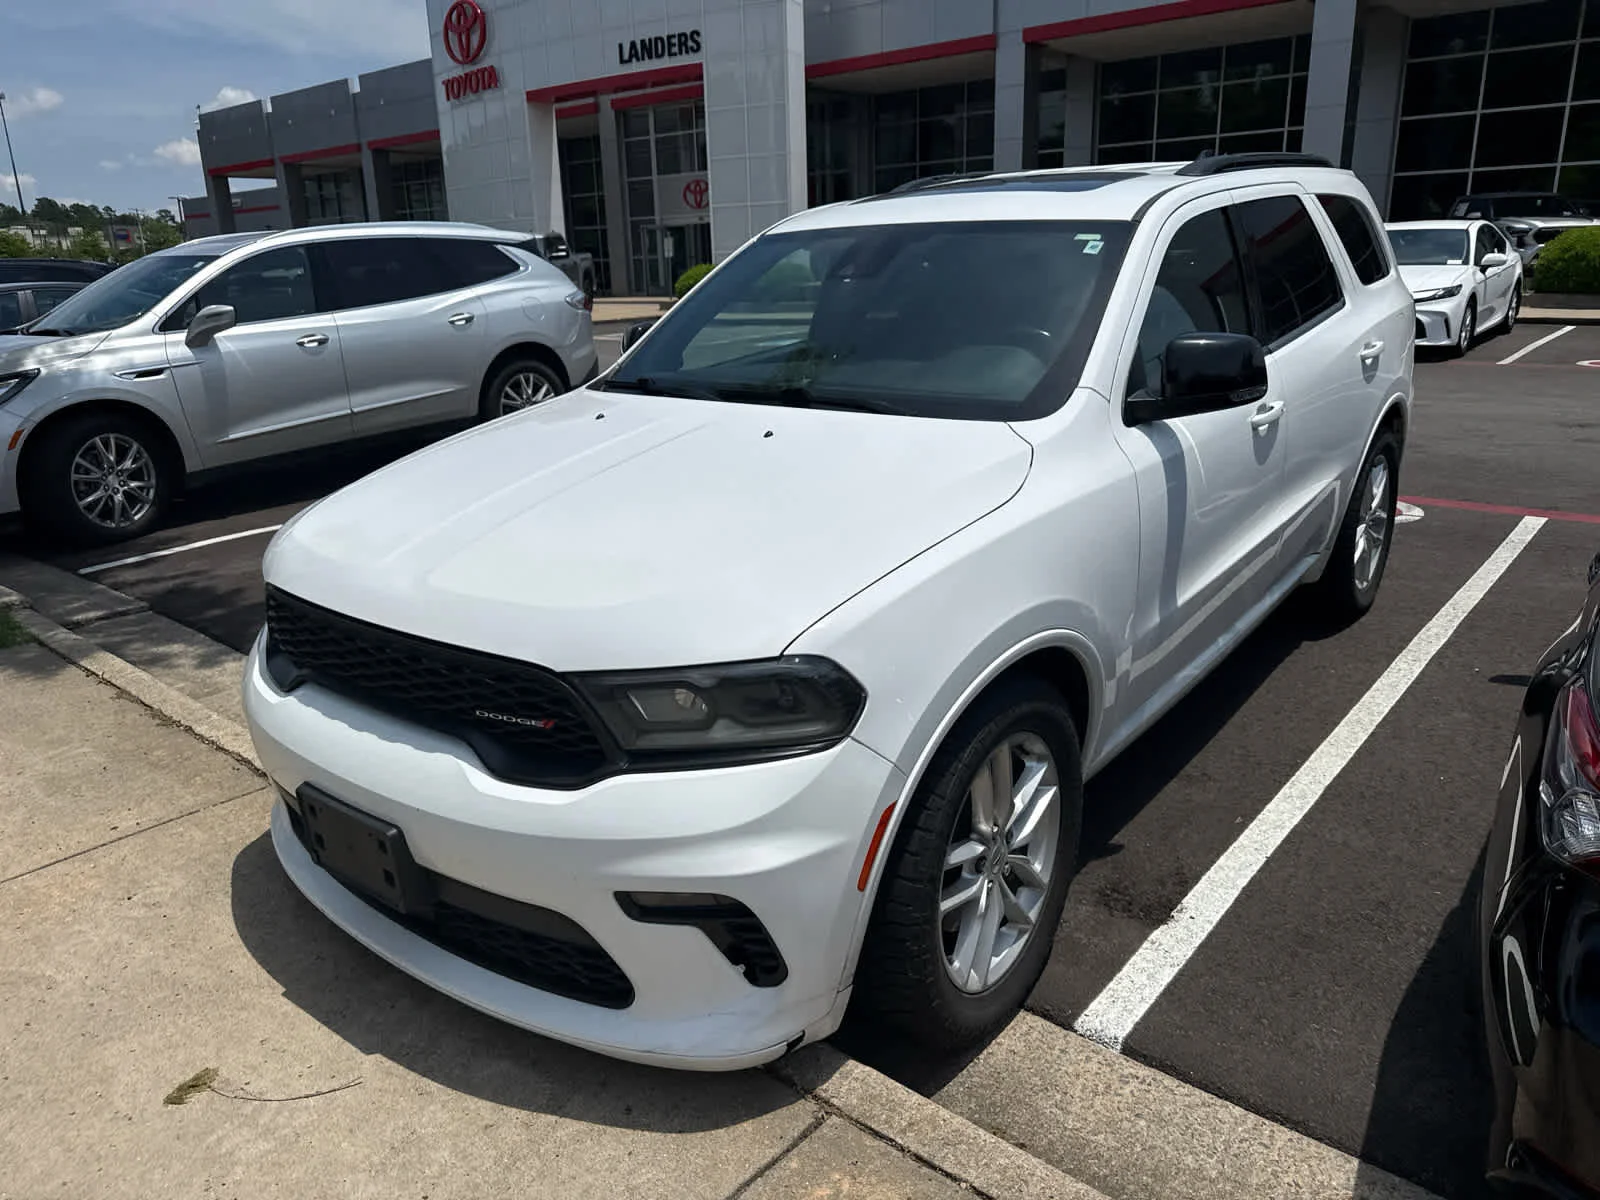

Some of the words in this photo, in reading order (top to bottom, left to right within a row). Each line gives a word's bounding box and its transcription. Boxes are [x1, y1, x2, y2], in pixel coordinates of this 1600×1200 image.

[618, 30, 702, 65] LANDERS
[442, 65, 499, 102] TOYOTA
[476, 710, 545, 728] DODGE
